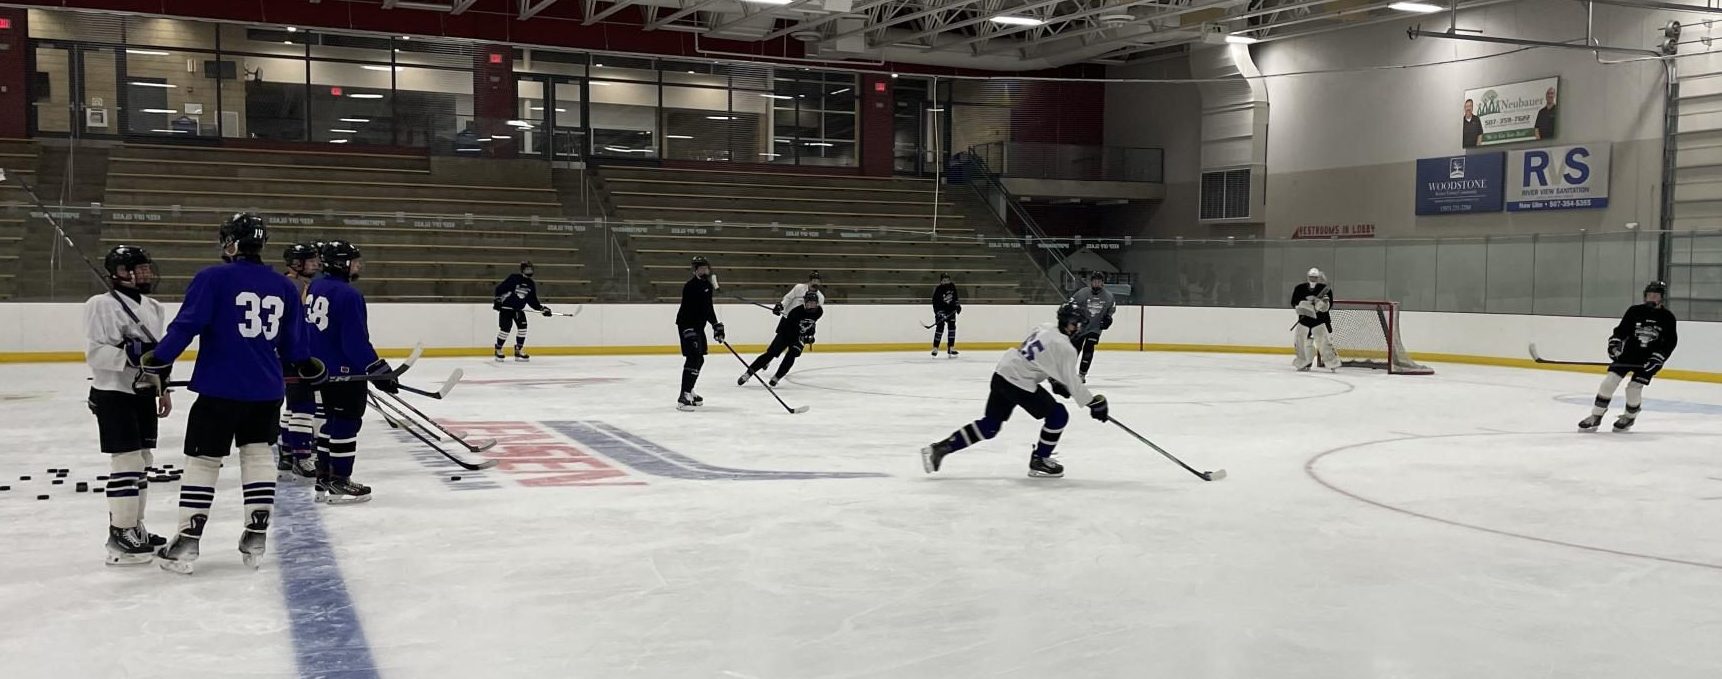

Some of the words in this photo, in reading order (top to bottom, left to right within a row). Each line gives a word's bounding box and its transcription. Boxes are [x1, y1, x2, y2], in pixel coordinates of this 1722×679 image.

[1500, 97, 1544, 110] Neubauer
[1523, 147, 1590, 187] RVS
[1428, 179, 1487, 191] WOODSTONE
[1521, 188, 1539, 196] RIVER
[1556, 186, 1590, 194] SANITATION
[254, 228, 264, 239] 14
[1298, 224, 1340, 235] RESTROOMS
[1352, 223, 1376, 234] LOBBY
[235, 291, 285, 341] 33
